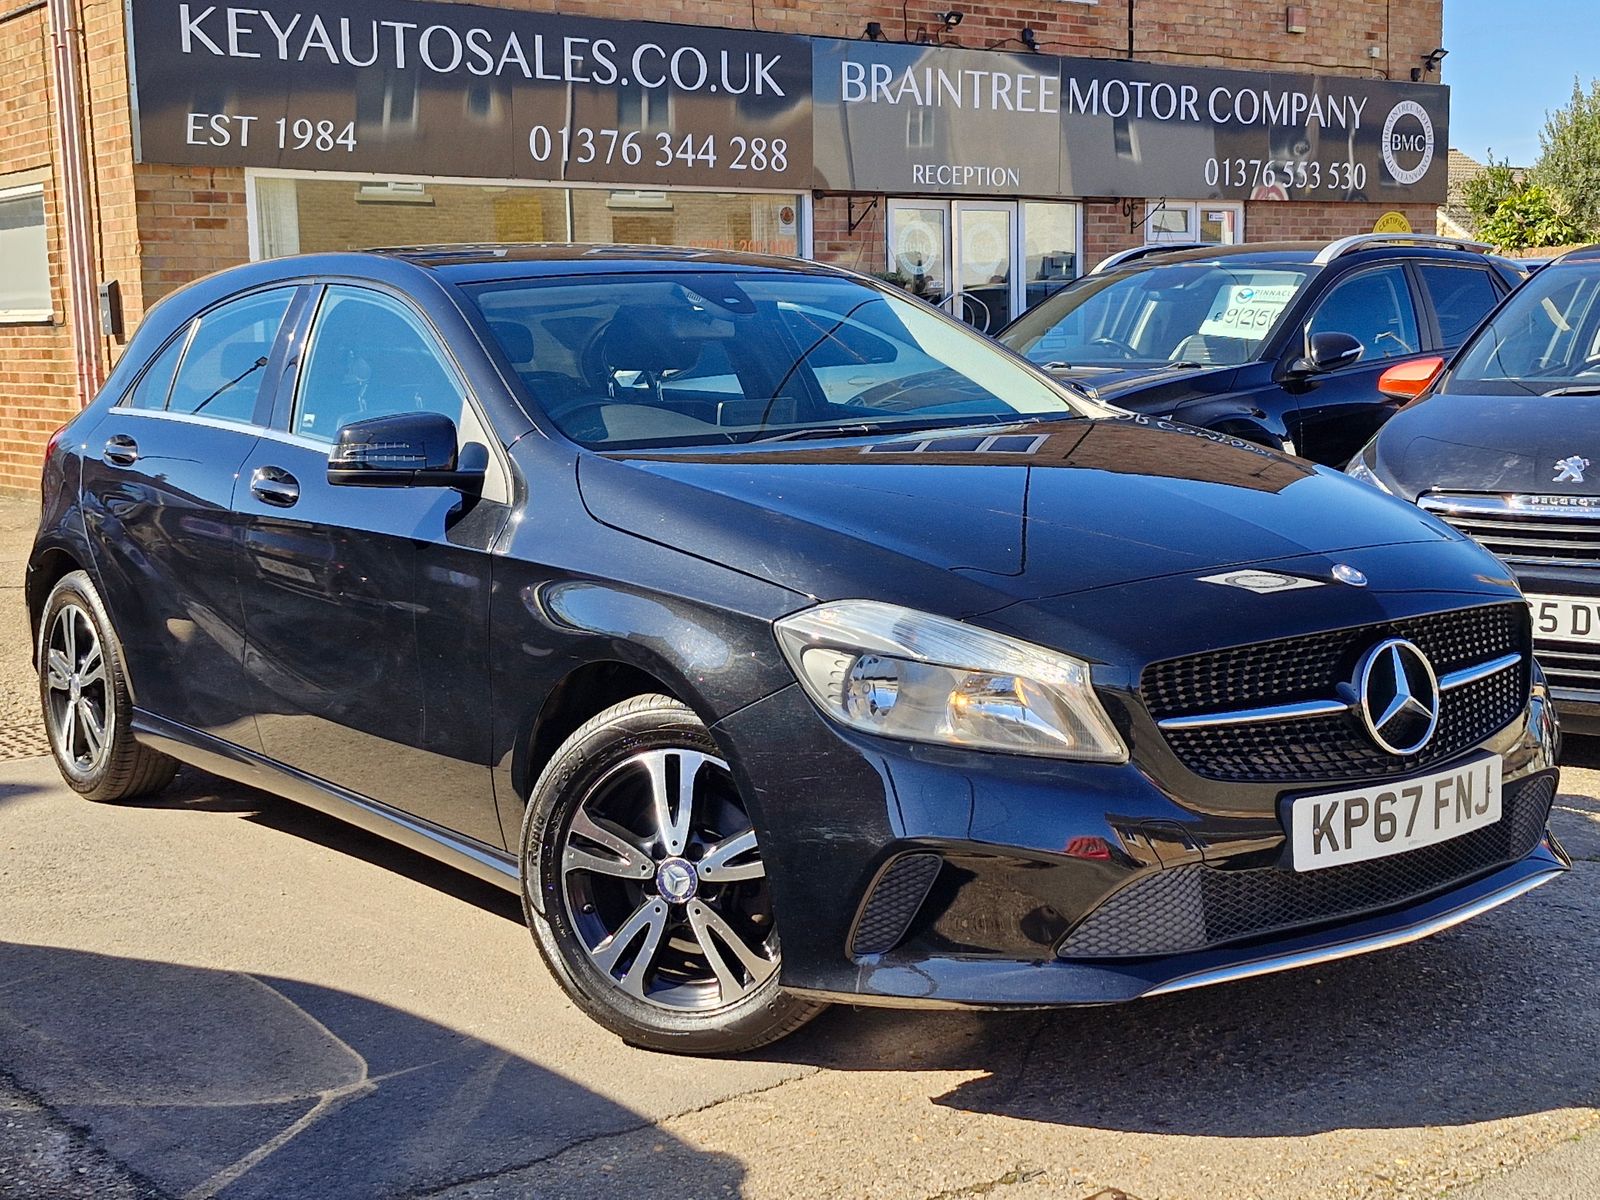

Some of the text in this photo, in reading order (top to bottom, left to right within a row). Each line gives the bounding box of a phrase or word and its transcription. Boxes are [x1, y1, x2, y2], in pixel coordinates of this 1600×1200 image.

[179, 4, 785, 96] KEYAUTOSALES.CO.UK
[842, 61, 1367, 129] BRAINTREE MOTOR COMPANY
[186, 113, 357, 152] EST 1984
[529, 125, 788, 172] 01376 344 288
[1392, 133, 1426, 152] BMC
[913, 164, 1020, 188] RECEPTION
[1204, 157, 1366, 190] 01376 553 530
[1531, 495, 1597, 506] PEUGEOT
[1312, 765, 1491, 855] KP67 FNJ
